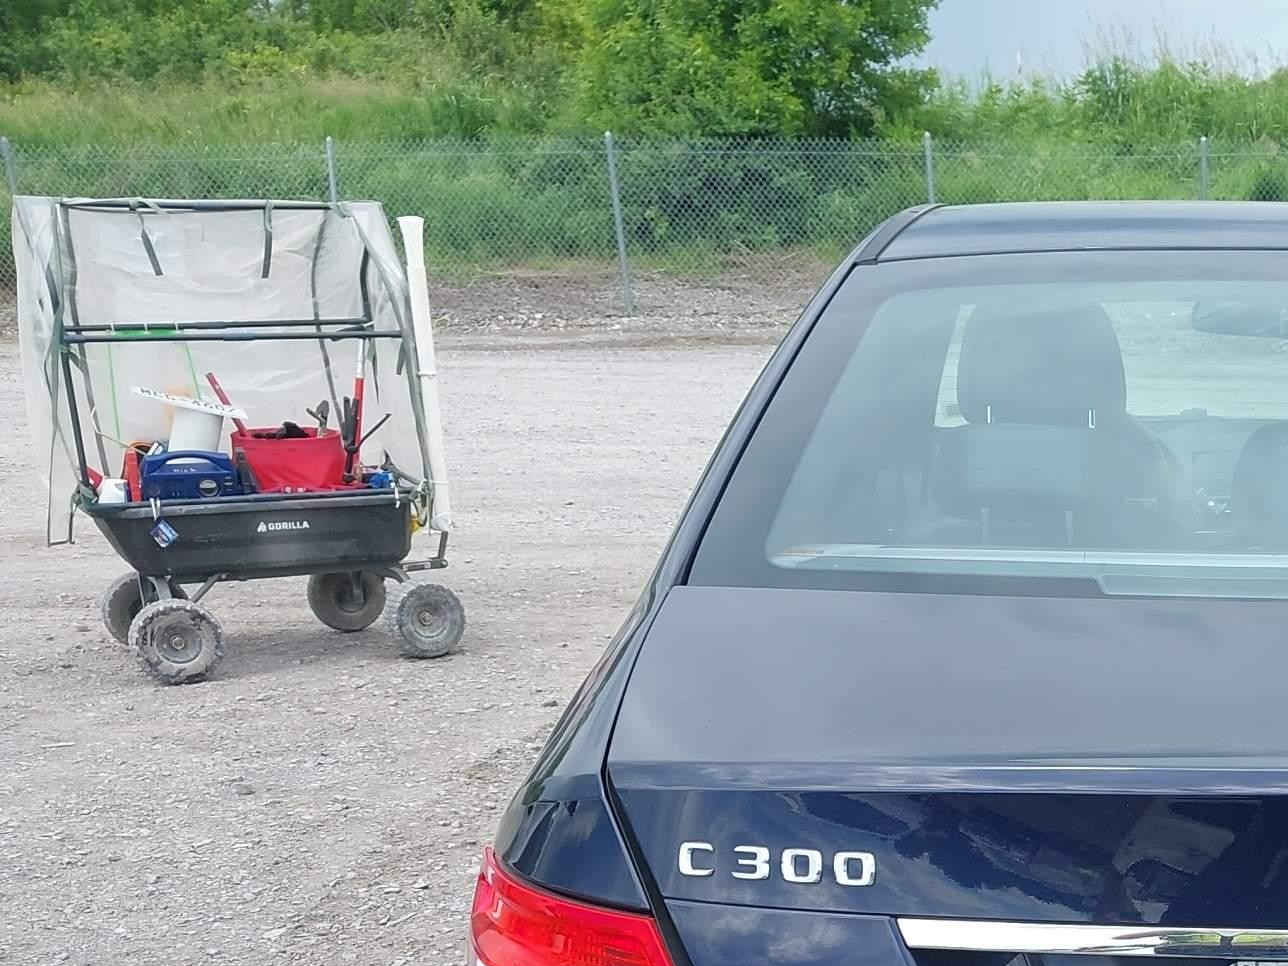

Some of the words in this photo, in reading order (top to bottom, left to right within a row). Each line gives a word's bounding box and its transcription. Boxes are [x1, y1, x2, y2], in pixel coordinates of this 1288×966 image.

[268, 520, 310, 530] GORILLA
[678, 841, 715, 876] C
[731, 845, 876, 887] 300
